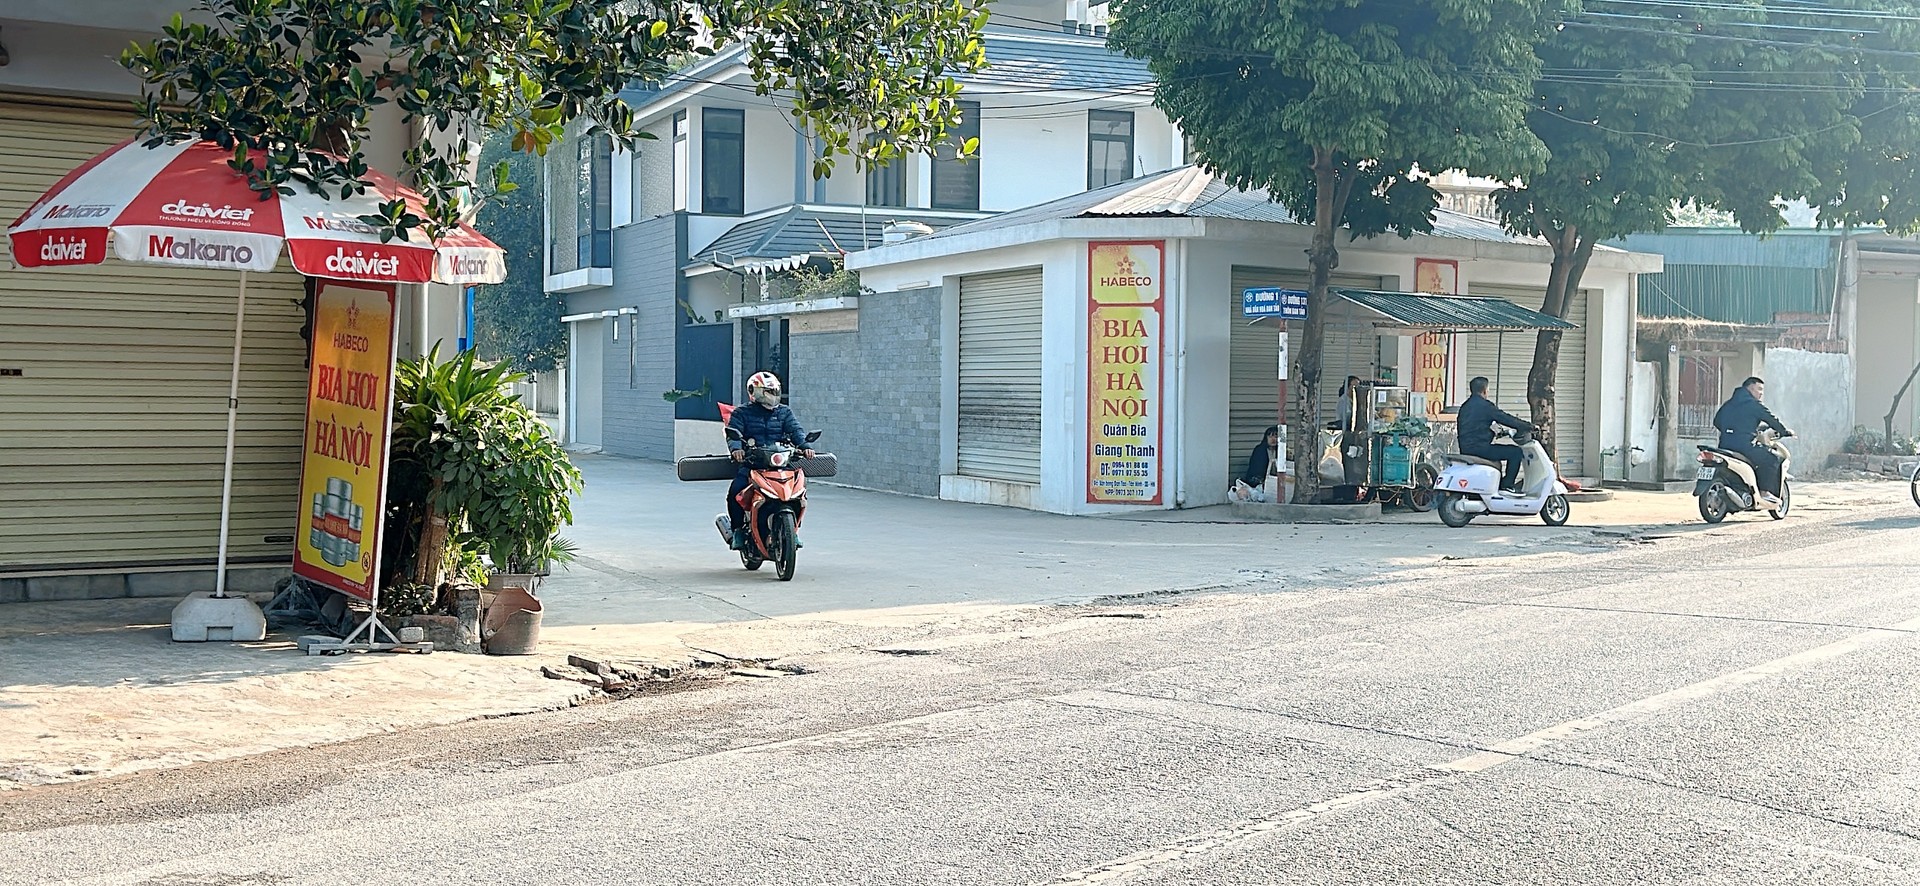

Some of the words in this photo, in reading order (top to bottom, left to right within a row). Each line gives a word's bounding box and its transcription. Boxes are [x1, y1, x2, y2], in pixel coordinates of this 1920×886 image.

[42, 204, 110, 219] Makano
[40, 235, 87, 261] daiviet
[148, 235, 253, 264] Makano
[326, 247, 400, 277] daiviet
[1100, 276, 1152, 287] HABECO
[1102, 319, 1149, 338] BIA
[333, 332, 370, 353] HABECO
[1102, 345, 1149, 365] HƠI
[316, 364, 343, 405] BIA
[1105, 369, 1145, 391] HÀ
[1424, 374, 1445, 393] HÀ
[1101, 395, 1149, 420] NỘI
[1130, 424, 1147, 437] Bia
[313, 412, 339, 460] HÀ
[338, 421, 374, 476] NỘI
[1094, 444, 1123, 458] Giang
[1125, 444, 1155, 457] Thanh
